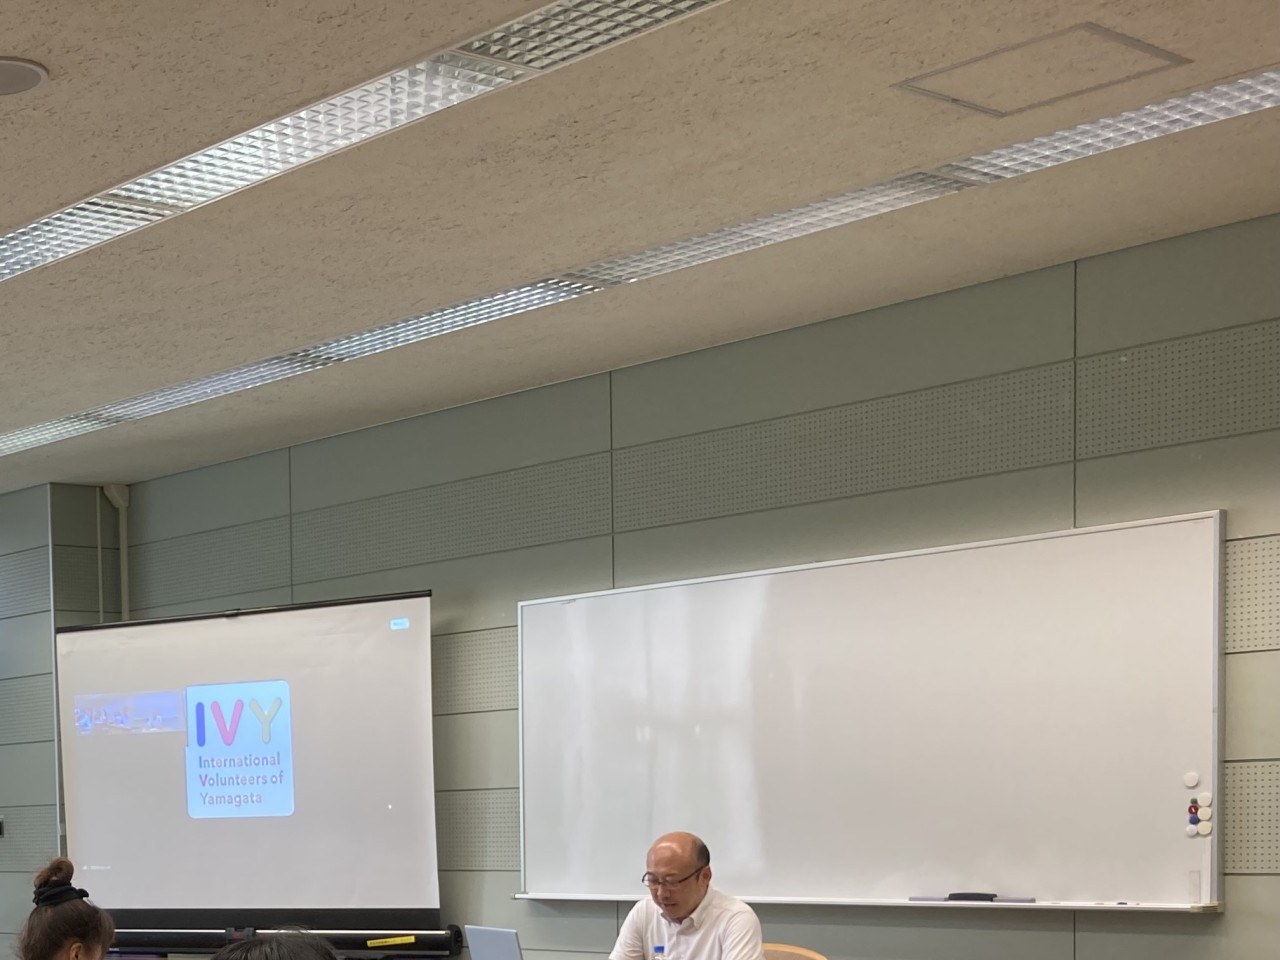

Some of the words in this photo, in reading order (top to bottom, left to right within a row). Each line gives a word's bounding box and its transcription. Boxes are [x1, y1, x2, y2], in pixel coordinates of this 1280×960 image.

[195, 697, 283, 748] IVY
[198, 752, 281, 769] International
[199, 773, 268, 787] Volunteers
[270, 770, 284, 784] of
[199, 792, 263, 808] Yamagata
